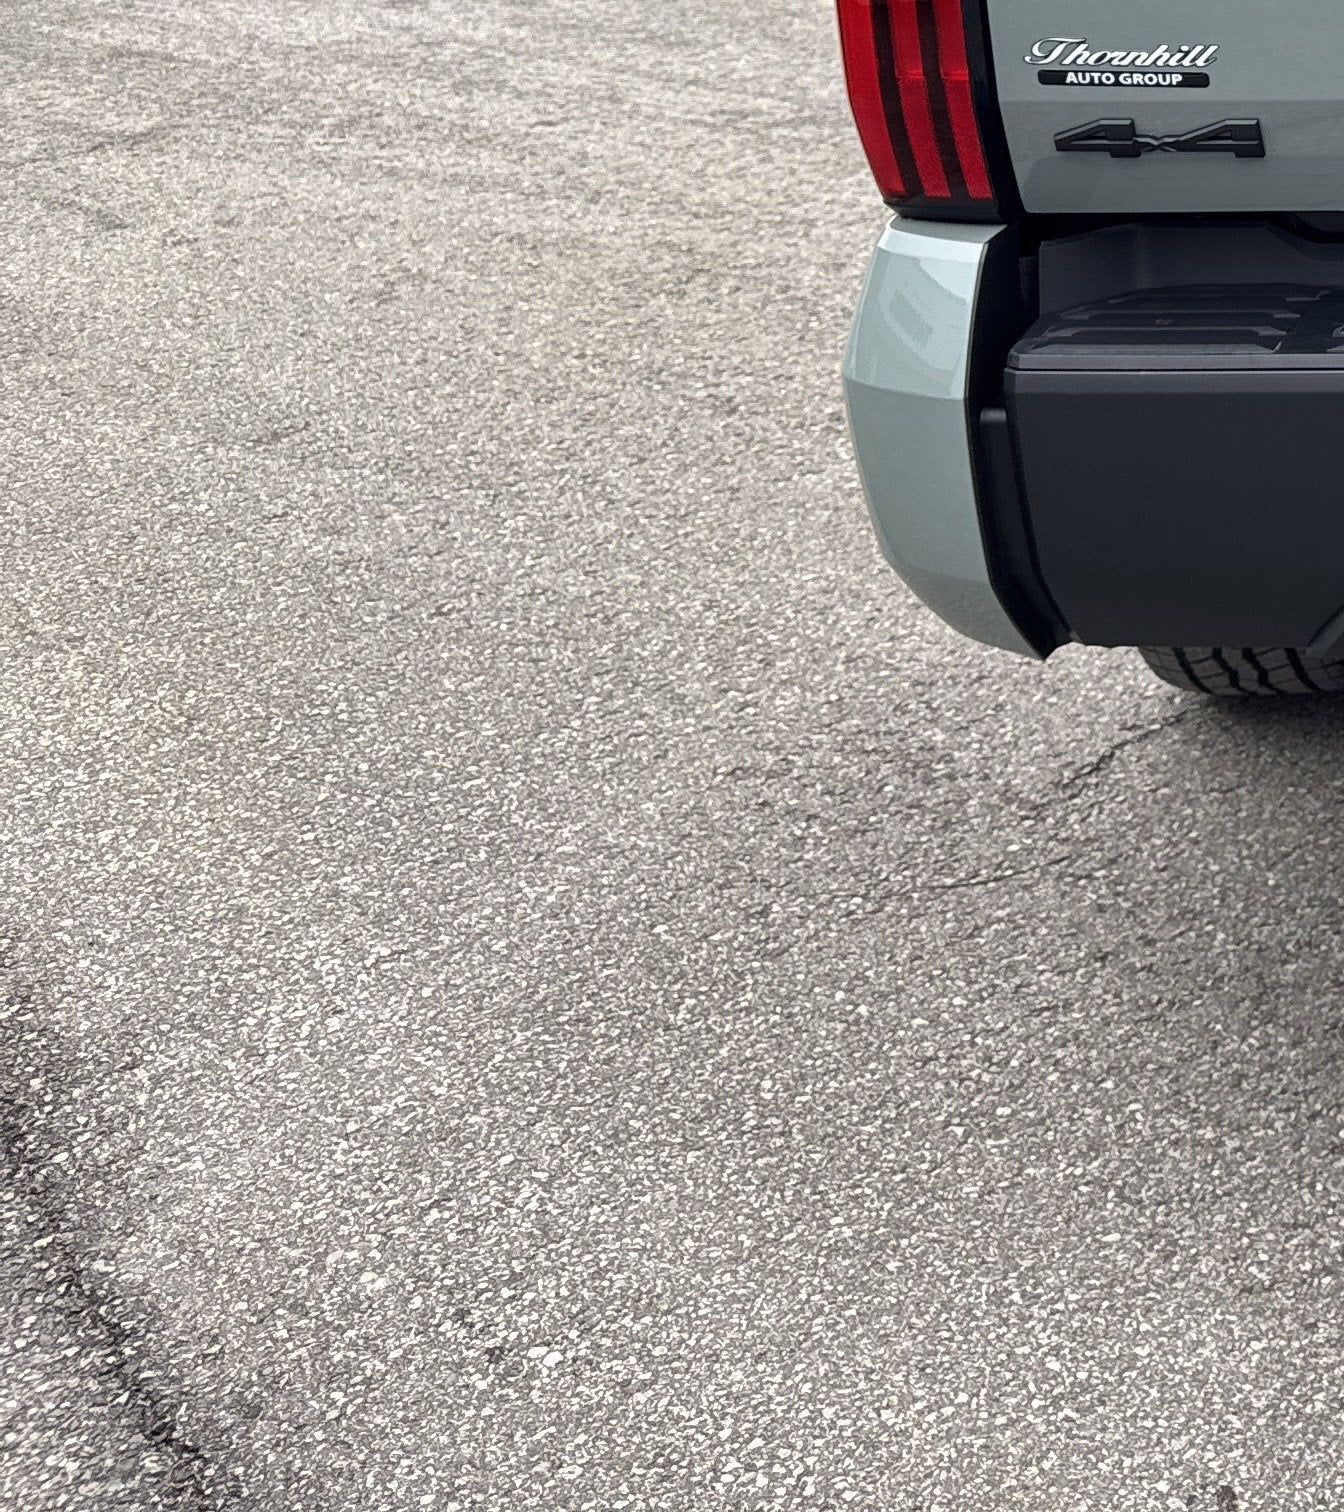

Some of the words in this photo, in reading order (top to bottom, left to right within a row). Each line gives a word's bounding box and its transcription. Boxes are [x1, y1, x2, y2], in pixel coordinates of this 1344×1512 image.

[1023, 36, 1219, 68] Thornhill
[1065, 72, 1114, 84] AUTO
[1119, 72, 1183, 86] GROUP
